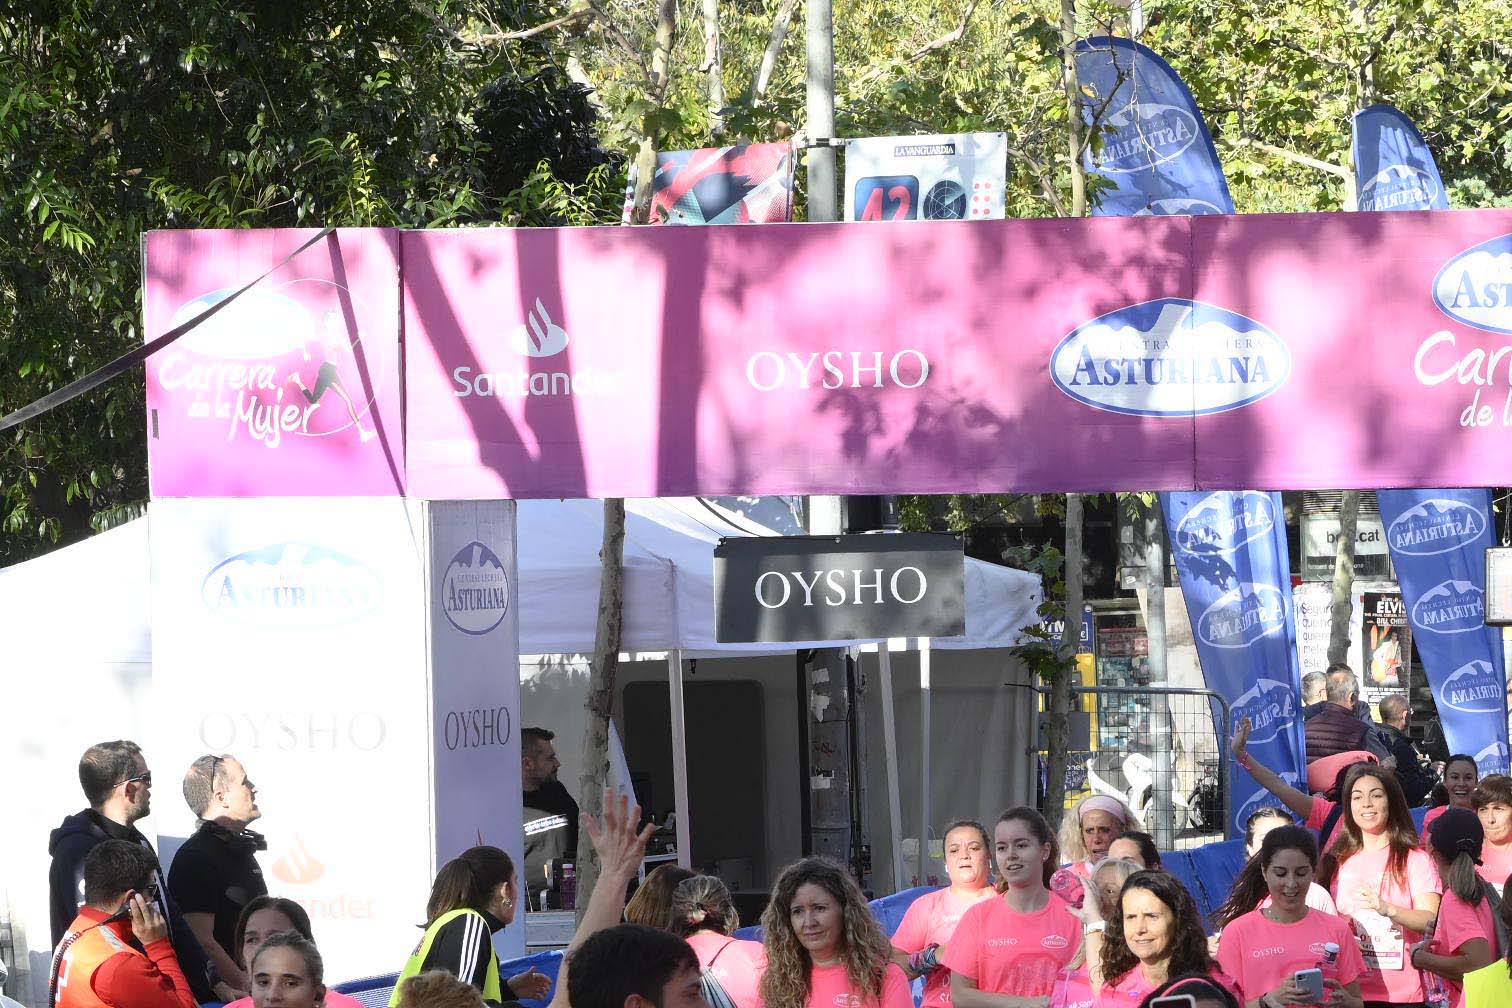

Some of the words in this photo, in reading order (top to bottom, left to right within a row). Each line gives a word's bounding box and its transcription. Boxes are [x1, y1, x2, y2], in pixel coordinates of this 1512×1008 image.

[747, 349, 929, 391] OYSHO
[1069, 344, 1271, 386] ASTURIANA
[229, 388, 321, 449] Mujer
[1460, 388, 1494, 427] de
[448, 578, 506, 612] ASTURIANA
[755, 566, 928, 609] OYSHO
[199, 711, 387, 751] OYSHO
[445, 706, 510, 751] OYSHO
[1253, 947, 1284, 958] OYSHO
